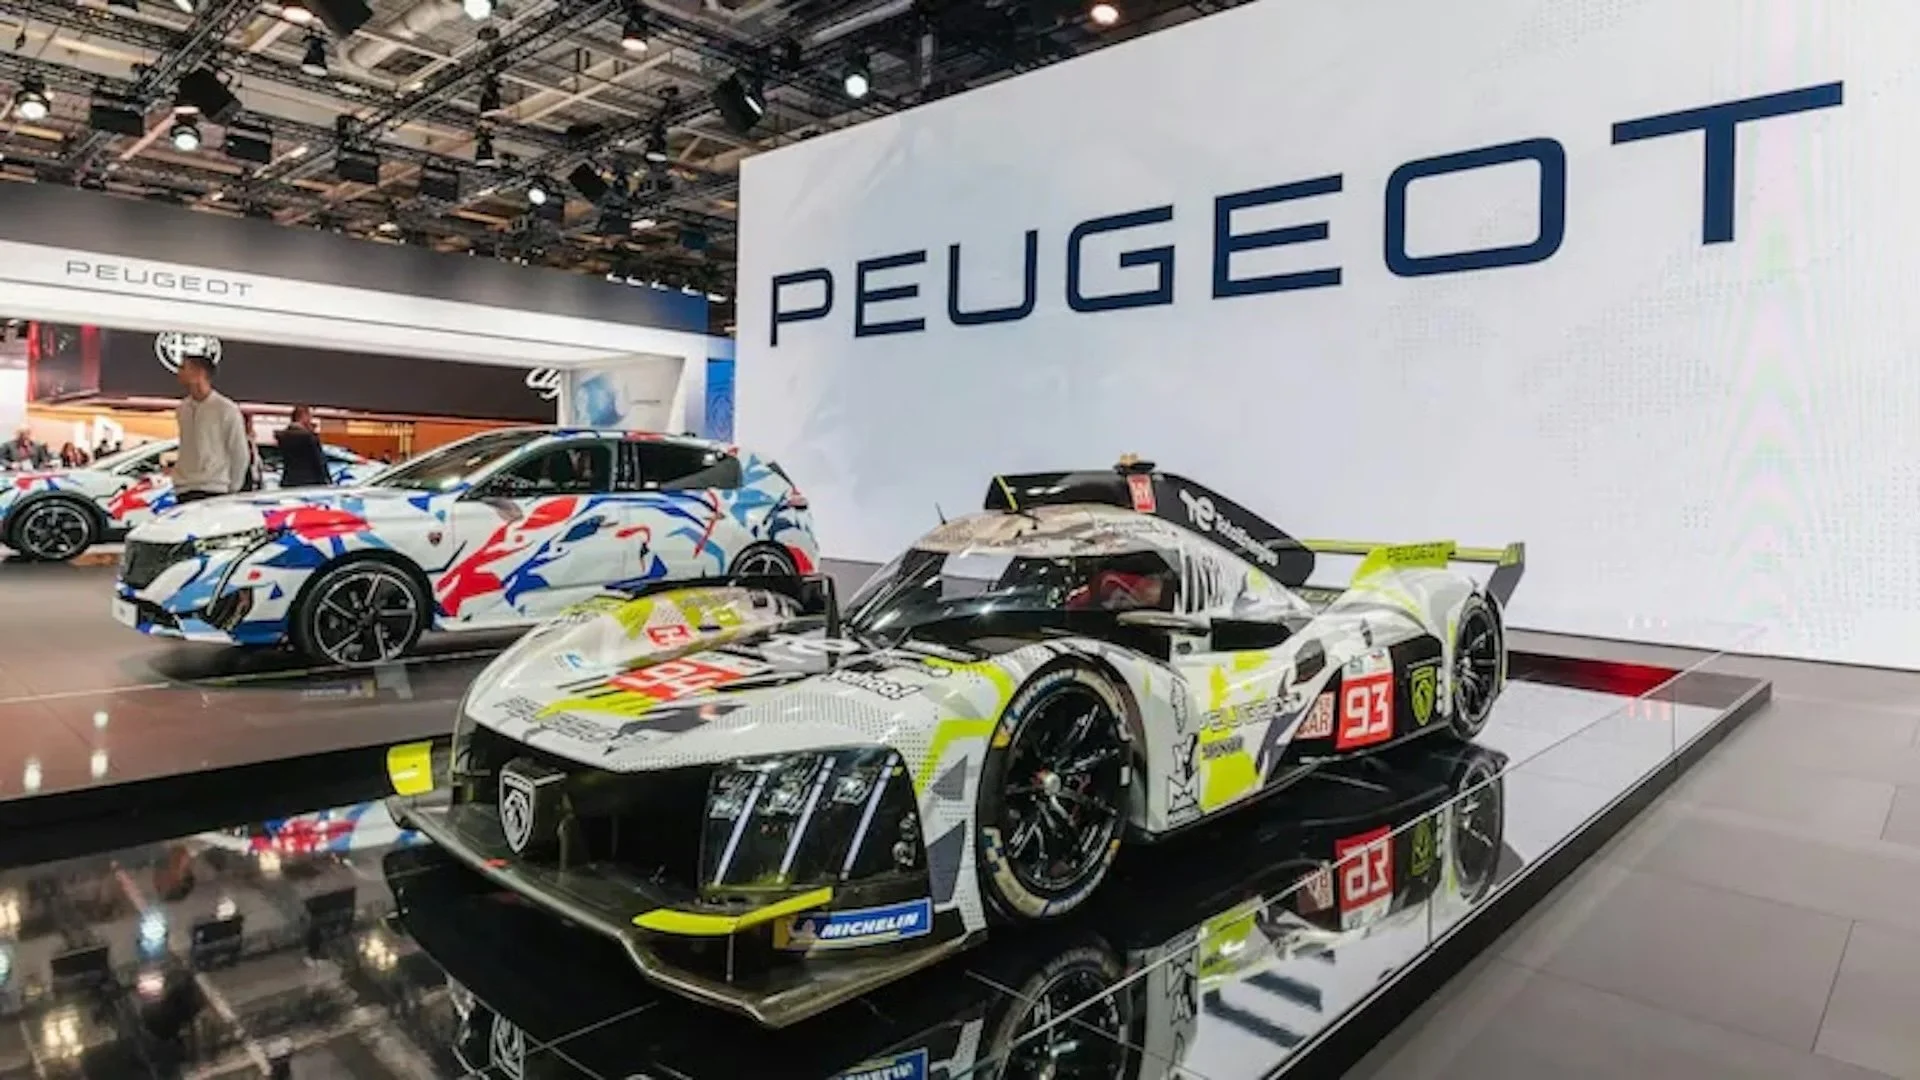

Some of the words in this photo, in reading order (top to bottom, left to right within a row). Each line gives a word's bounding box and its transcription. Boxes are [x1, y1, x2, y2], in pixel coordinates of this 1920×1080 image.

[769, 81, 1843, 347] PEUGEOT
[66, 260, 253, 297] PEUGEOT
[1386, 543, 1444, 561] PEUGEOT
[1344, 681, 1390, 740] 93
[820, 911, 920, 939] MICHELIN
